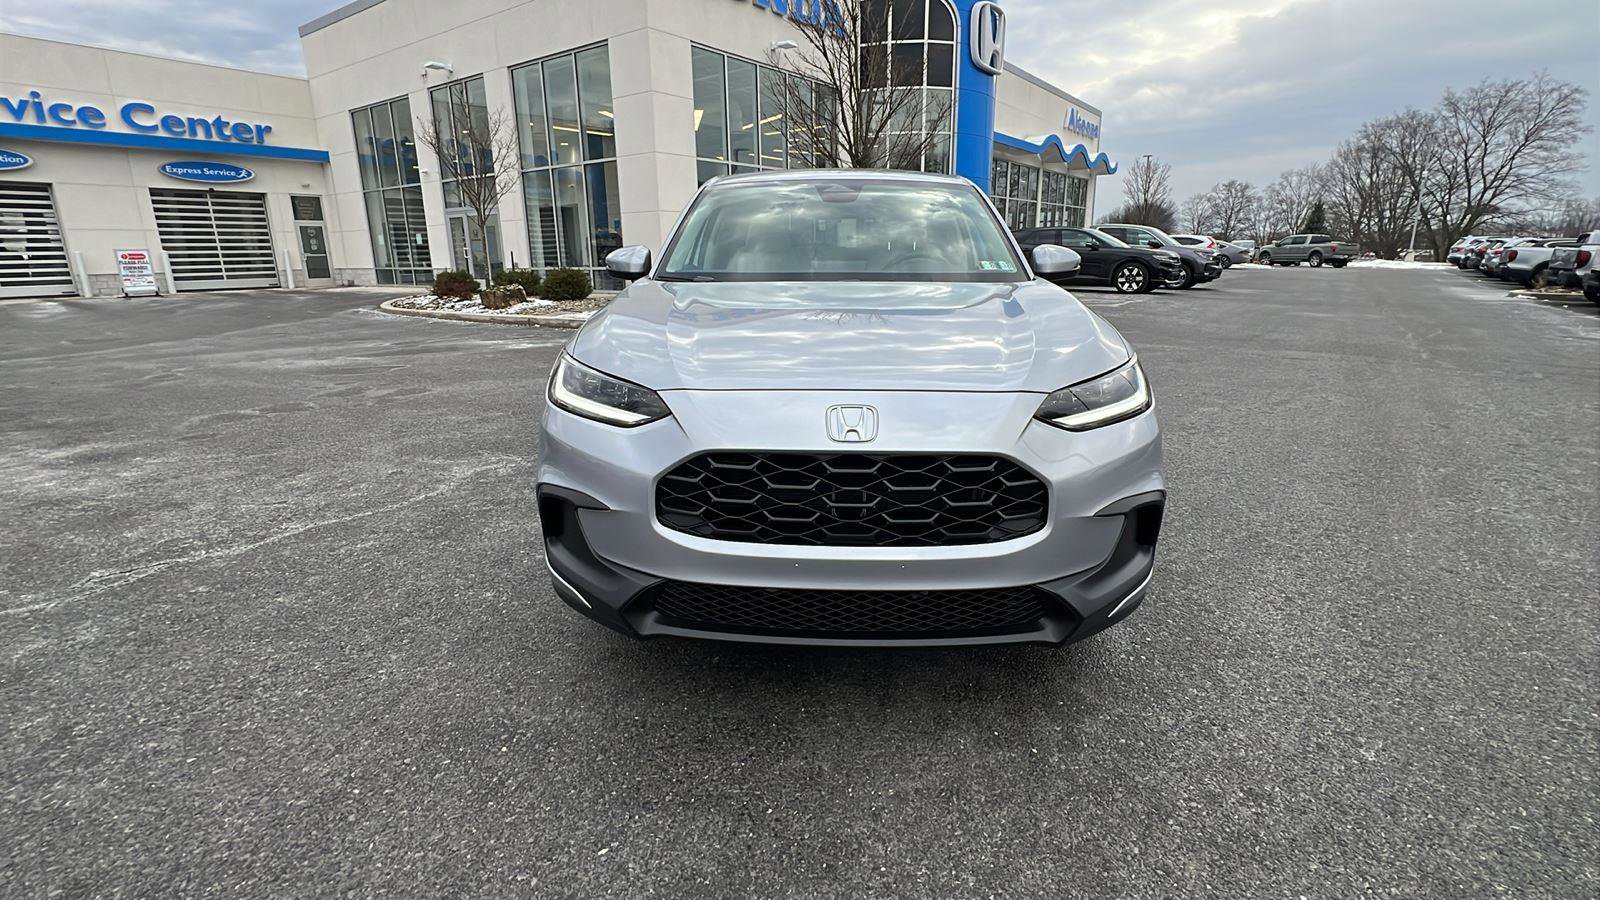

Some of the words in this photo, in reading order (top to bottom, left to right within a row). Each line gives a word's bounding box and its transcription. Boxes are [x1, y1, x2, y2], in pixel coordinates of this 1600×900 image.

[120, 102, 272, 144] Center
[165, 165, 202, 175] Express
[203, 167, 236, 177] Service
